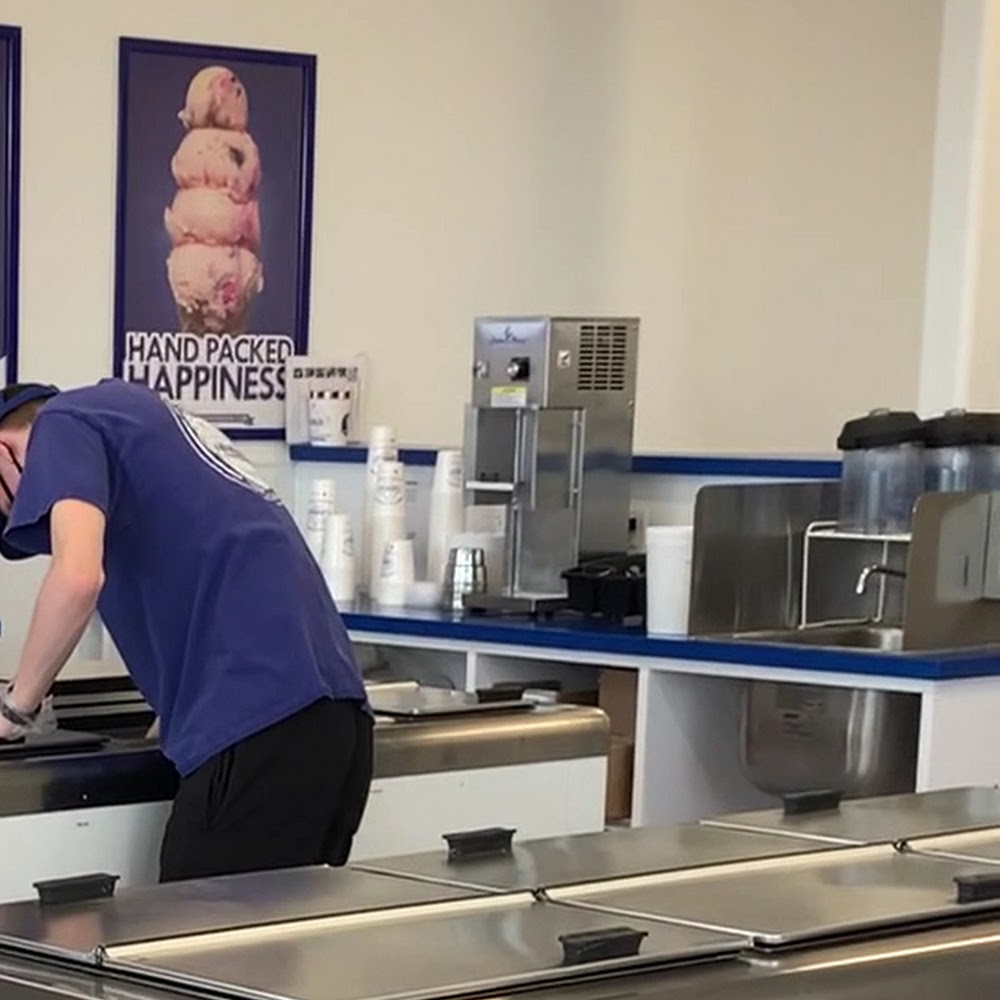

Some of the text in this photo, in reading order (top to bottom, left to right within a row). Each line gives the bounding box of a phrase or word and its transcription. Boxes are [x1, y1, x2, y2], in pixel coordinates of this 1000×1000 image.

[127, 335, 293, 364] HAND PACKED
[127, 365, 286, 401] HAPPINESS
